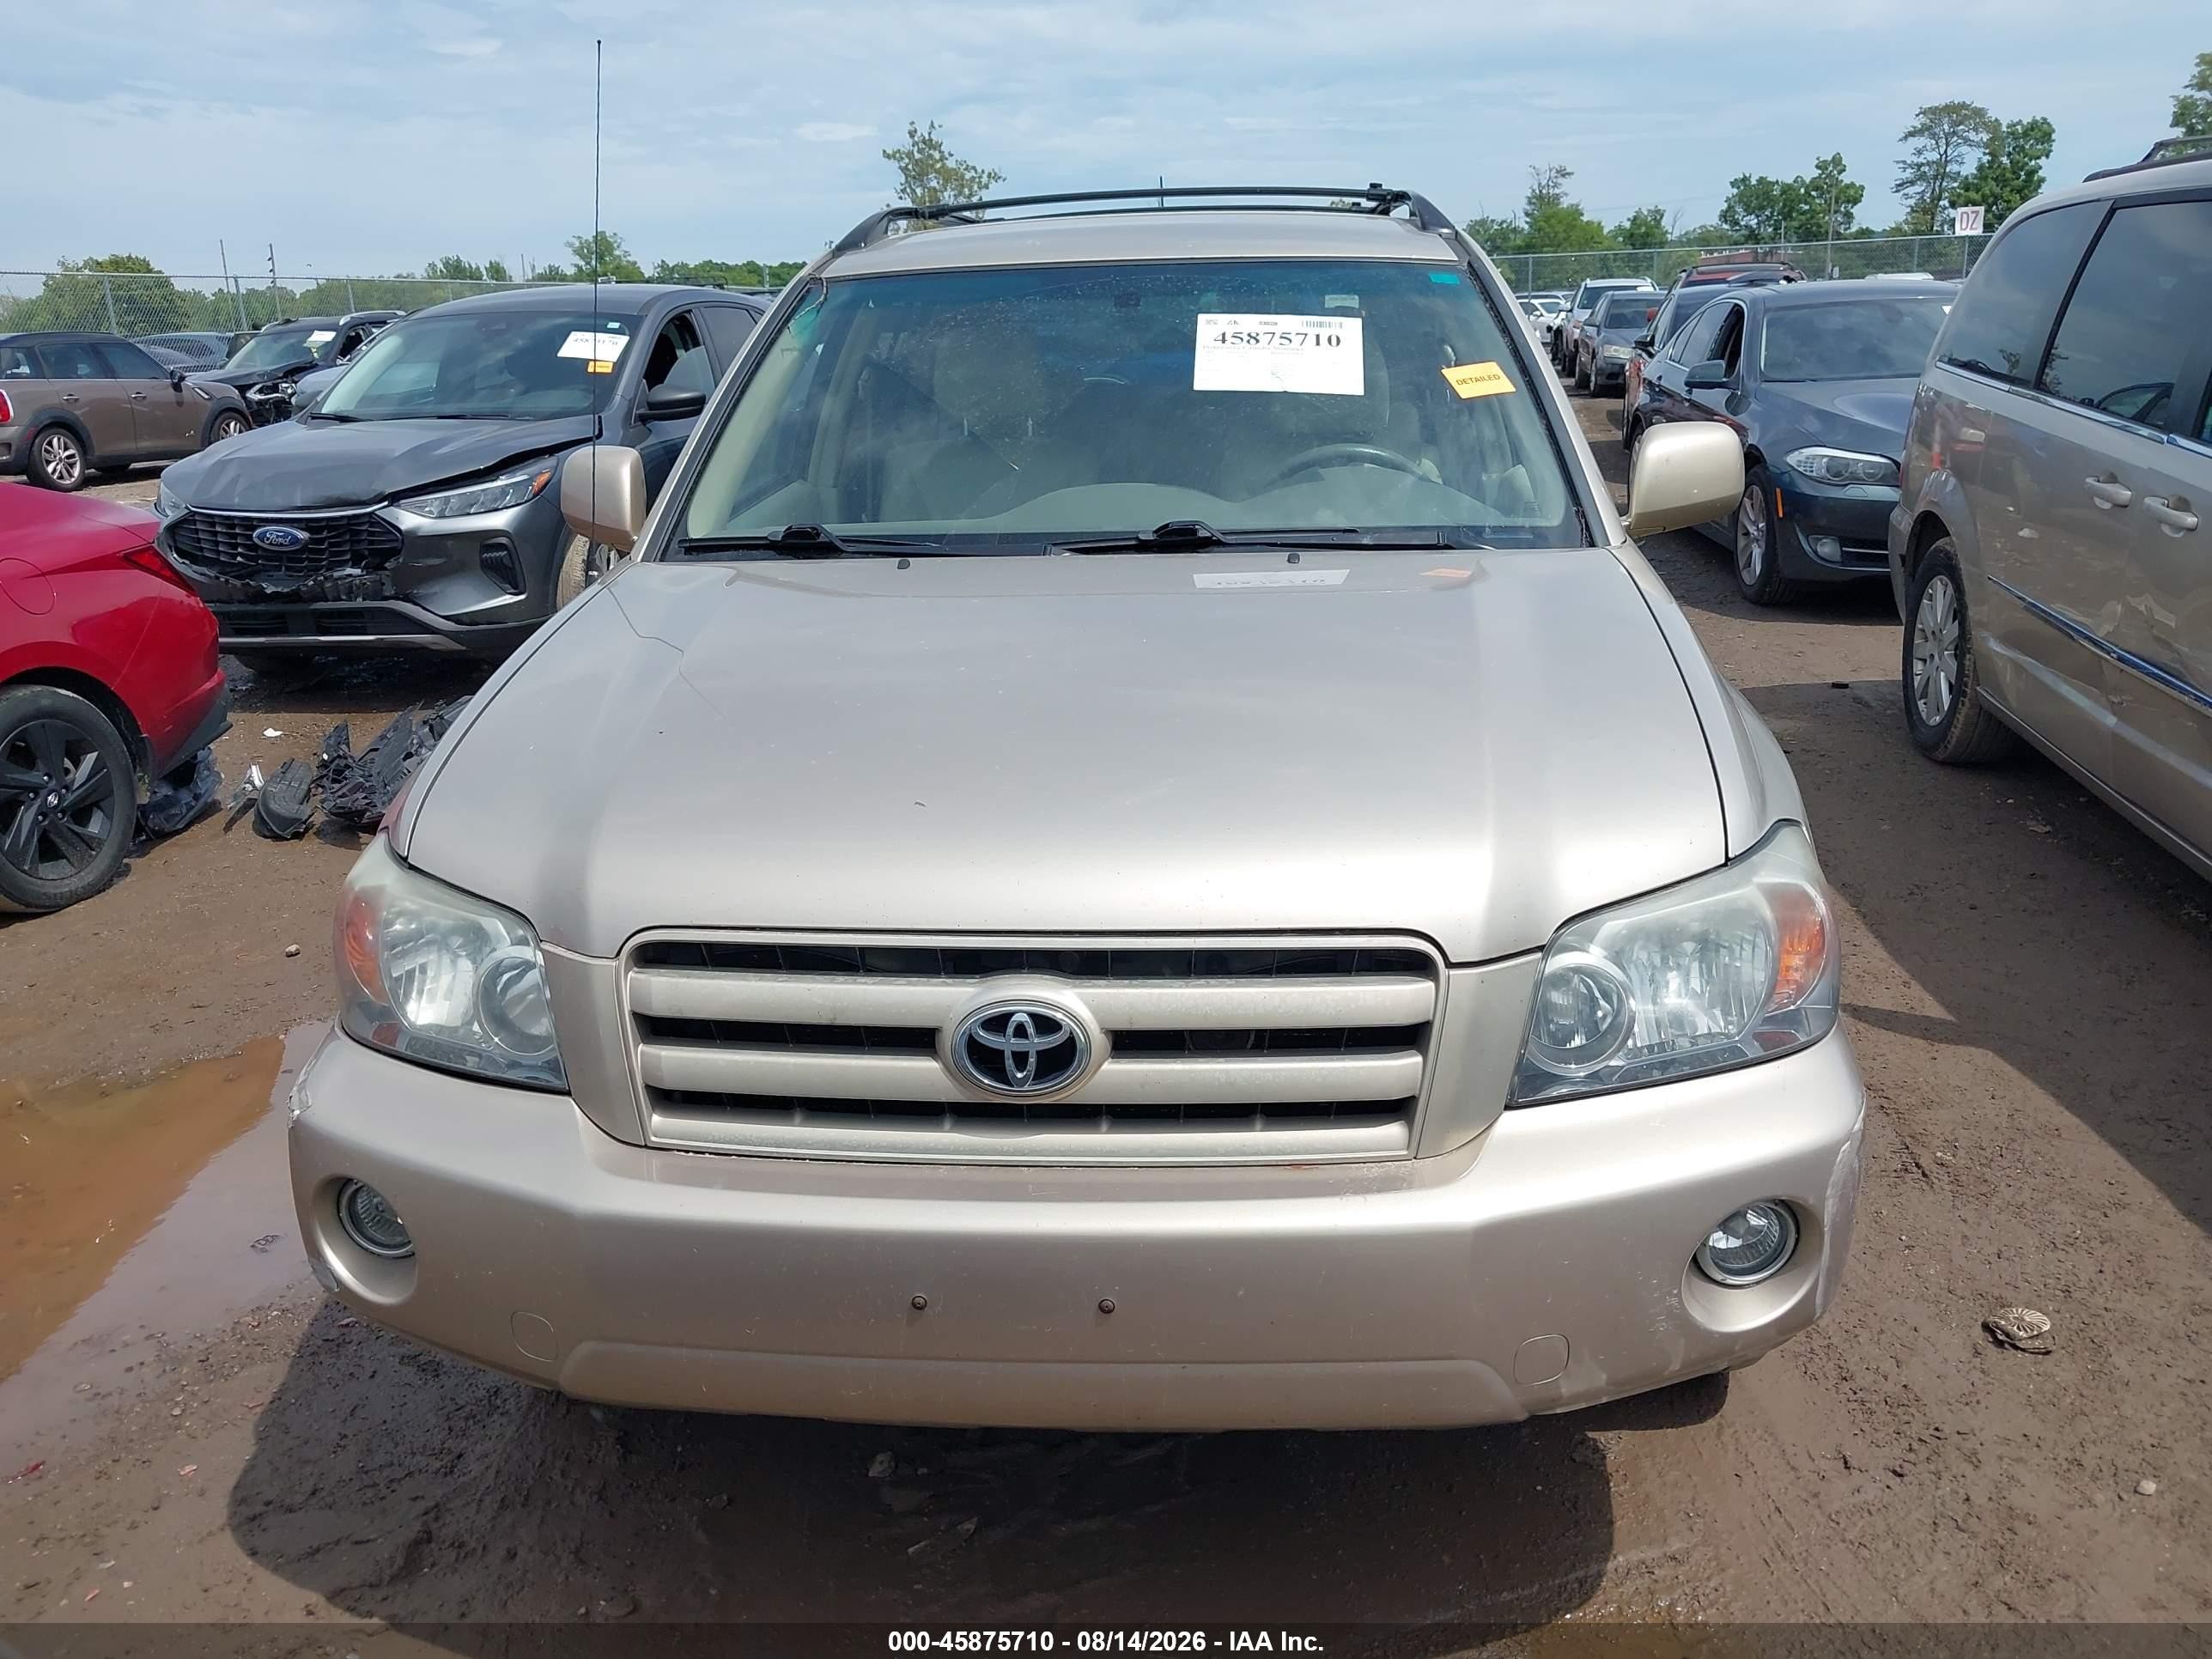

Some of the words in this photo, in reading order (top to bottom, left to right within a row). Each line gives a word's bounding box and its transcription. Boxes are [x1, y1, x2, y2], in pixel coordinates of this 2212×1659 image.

[1212, 331, 1341, 348] 45875710
[1456, 374, 1501, 386] DETAILED
[264, 532, 291, 544] Ford
